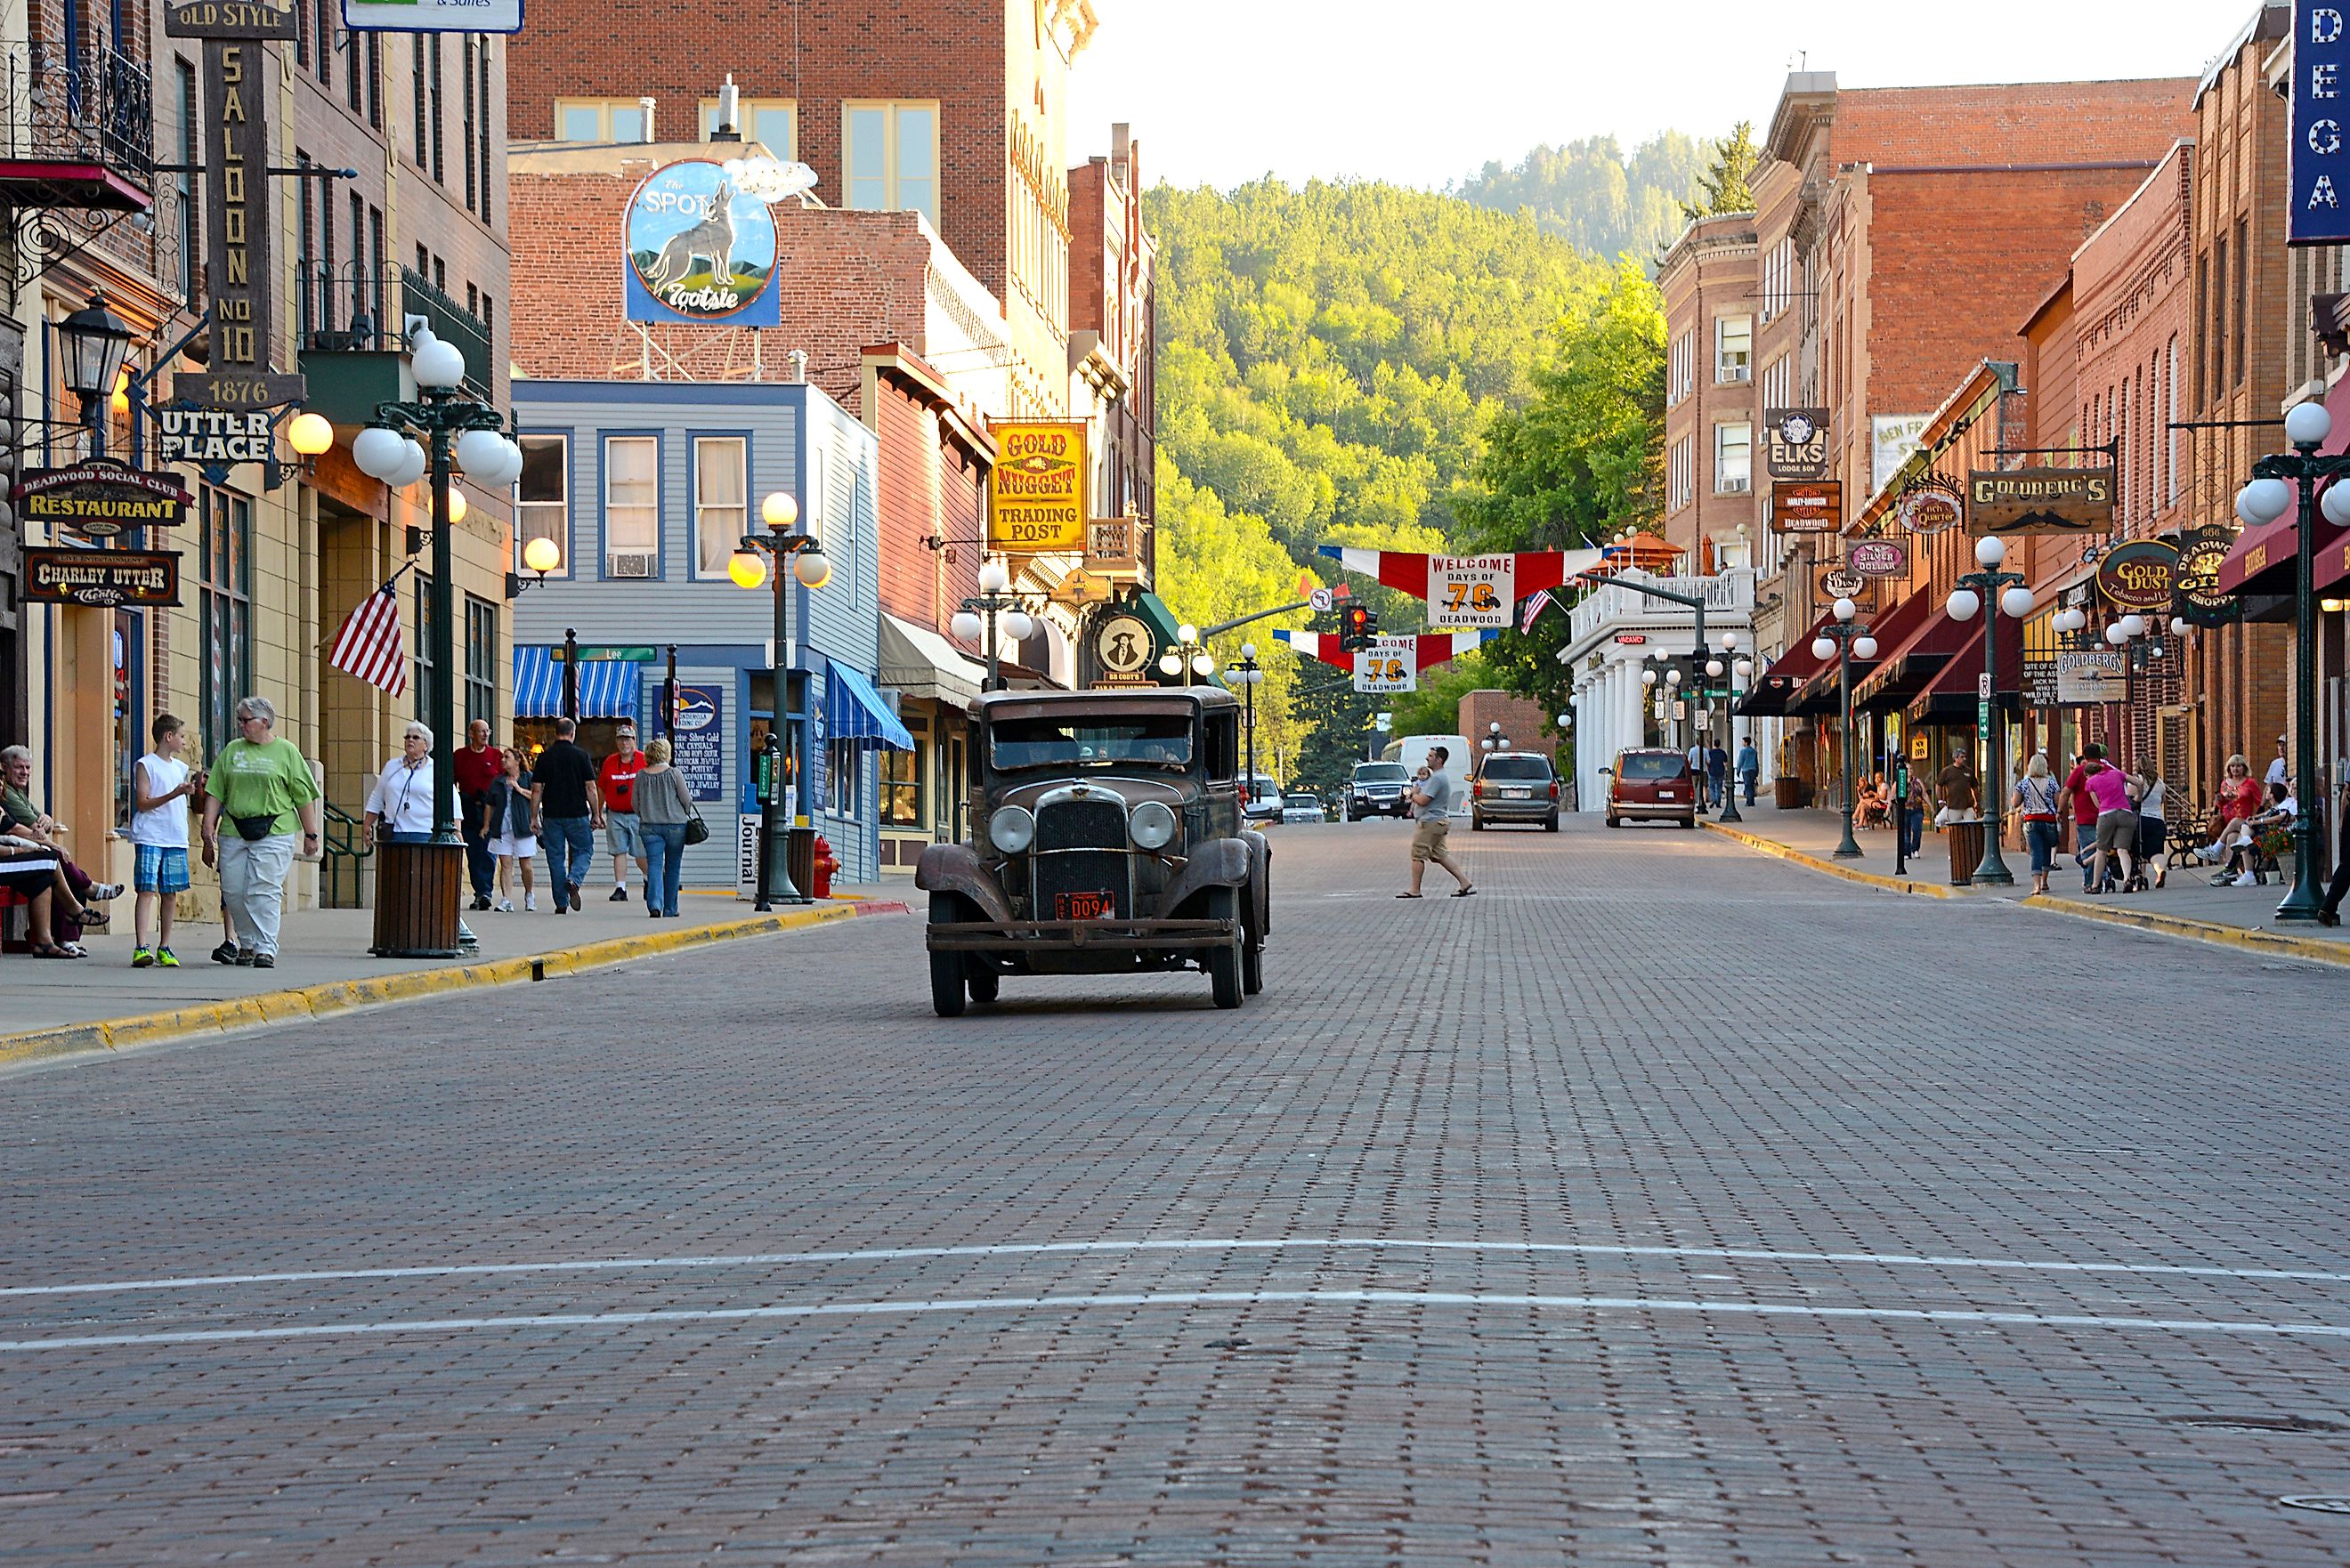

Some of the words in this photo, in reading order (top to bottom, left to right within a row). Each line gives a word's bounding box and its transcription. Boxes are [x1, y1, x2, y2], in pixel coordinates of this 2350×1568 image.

[180, 4, 217, 25] OLD
[223, 3, 281, 27] STYLE
[2308, 8, 2343, 210] DEGA
[222, 46, 247, 285] SALOON
[663, 180, 684, 190] The
[645, 190, 710, 215] SPOT
[219, 298, 250, 321] NO
[668, 282, 739, 314] Tootsie
[222, 327, 255, 362] 10
[208, 380, 269, 403] 1876
[162, 411, 271, 436] UTTER
[162, 435, 269, 460] PLACE
[1008, 433, 1066, 457] GOLD
[1771, 444, 1824, 463] ELKS
[24, 470, 95, 493] DEADWOOD
[99, 471, 143, 485] SOCIAL
[147, 478, 179, 497] CLUB
[998, 467, 1075, 495] NUGGET
[1975, 475, 2106, 504] GOLDBERG'S
[29, 495, 177, 519] RESTAURANT
[1787, 497, 1827, 506] HARLEY-DAVIDSON
[999, 508, 1078, 523] TRADING
[1785, 518, 1828, 528] DEADWOOD
[1918, 513, 1955, 526] Quarter
[1011, 524, 1062, 540] POST
[1432, 558, 1511, 574] WELCOME
[1859, 562, 1895, 570] DOLLAR
[1860, 554, 1893, 562] SILVER
[2178, 541, 2232, 571] DEADWO
[37, 563, 107, 585] CHARLEY
[113, 567, 165, 588] UTTER
[1447, 573, 1477, 581] DAYS
[1481, 573, 1495, 581] OF
[2117, 562, 2168, 579] GOLD
[2108, 582, 2142, 602] Tobacco
[2143, 592, 2158, 602] and
[2128, 576, 2173, 590] DUST
[1447, 583, 1495, 612] 76
[1439, 615, 1502, 623] DEADWOOD
[1617, 635, 1644, 643] VACANCY
[606, 648, 622, 659] Lee
[1368, 659, 1403, 683] 76
[1915, 748, 1925, 756] OPEN
[741, 816, 757, 885] Journal
